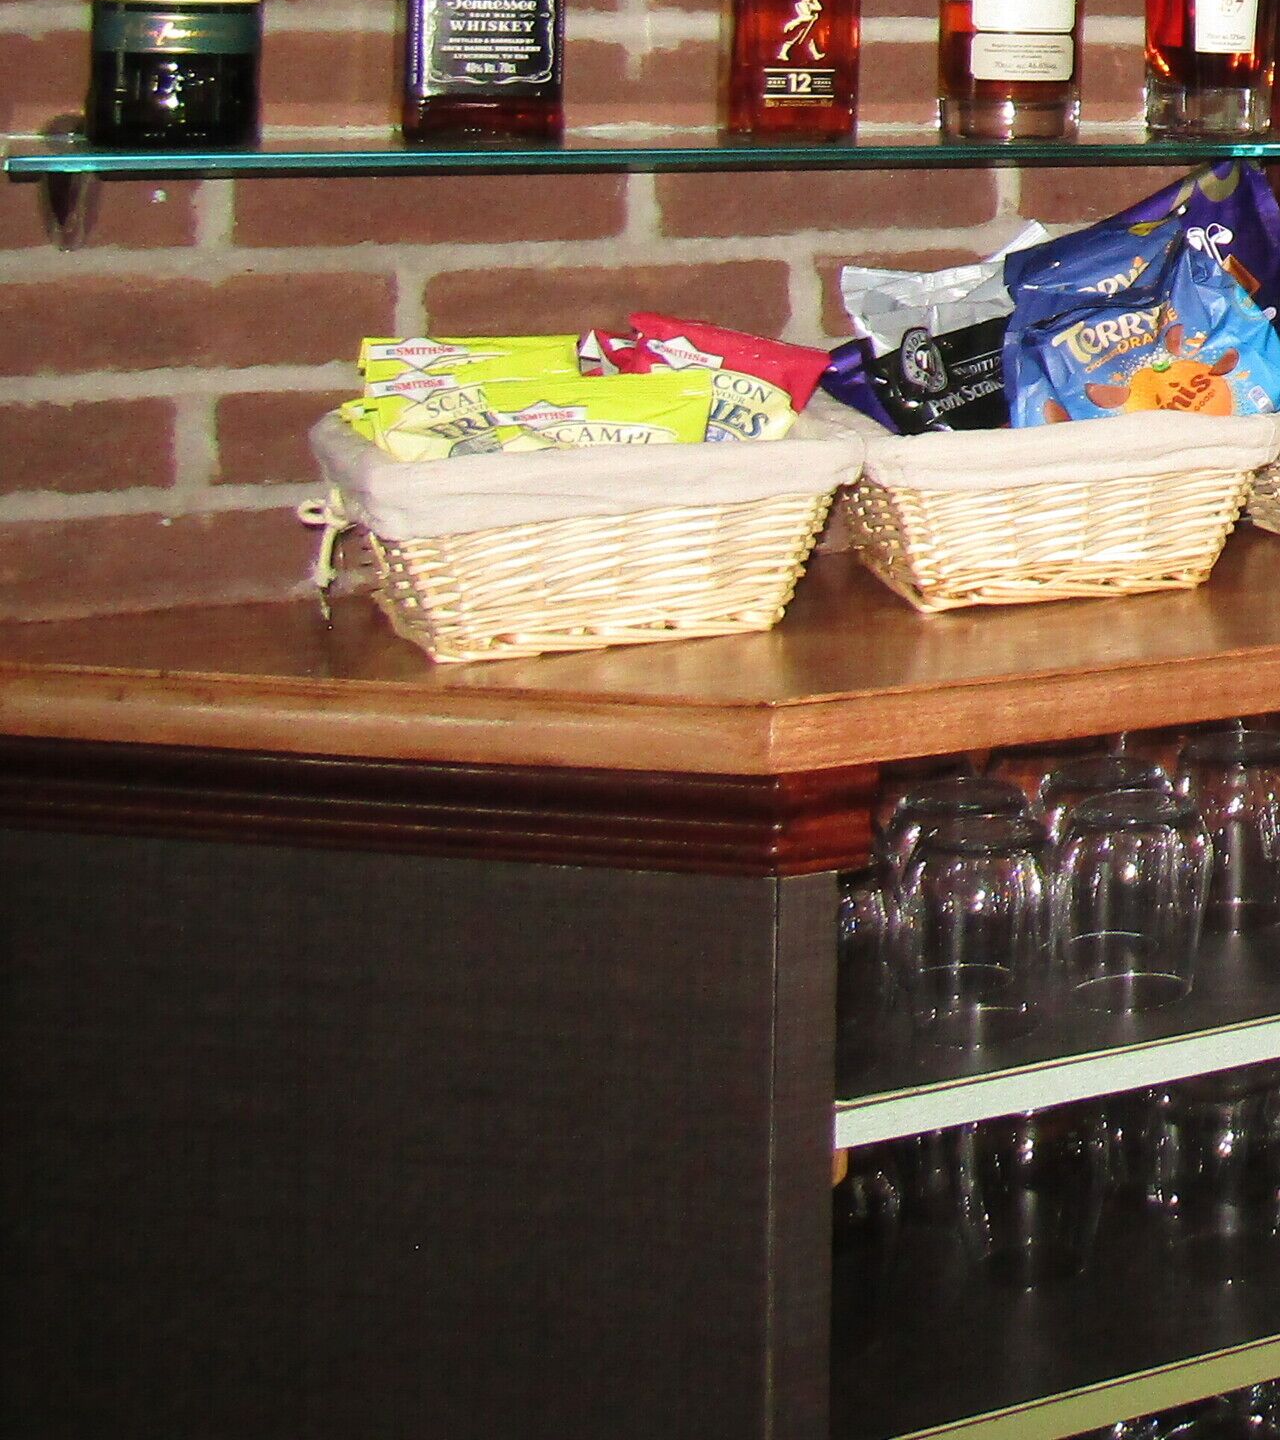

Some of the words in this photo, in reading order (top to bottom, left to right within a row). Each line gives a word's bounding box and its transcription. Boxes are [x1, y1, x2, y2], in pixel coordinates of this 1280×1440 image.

[449, 20, 536, 33] WHISKEY
[786, 73, 812, 92] 12
[395, 345, 446, 356] SMITHS
[659, 343, 701, 363] SMITHS
[393, 378, 437, 392] SMITHS
[713, 373, 774, 404] CON
[714, 389, 746, 404] VOUR
[518, 409, 567, 421] SMITHS
[710, 399, 769, 437] IES
[429, 410, 500, 440] FRI
